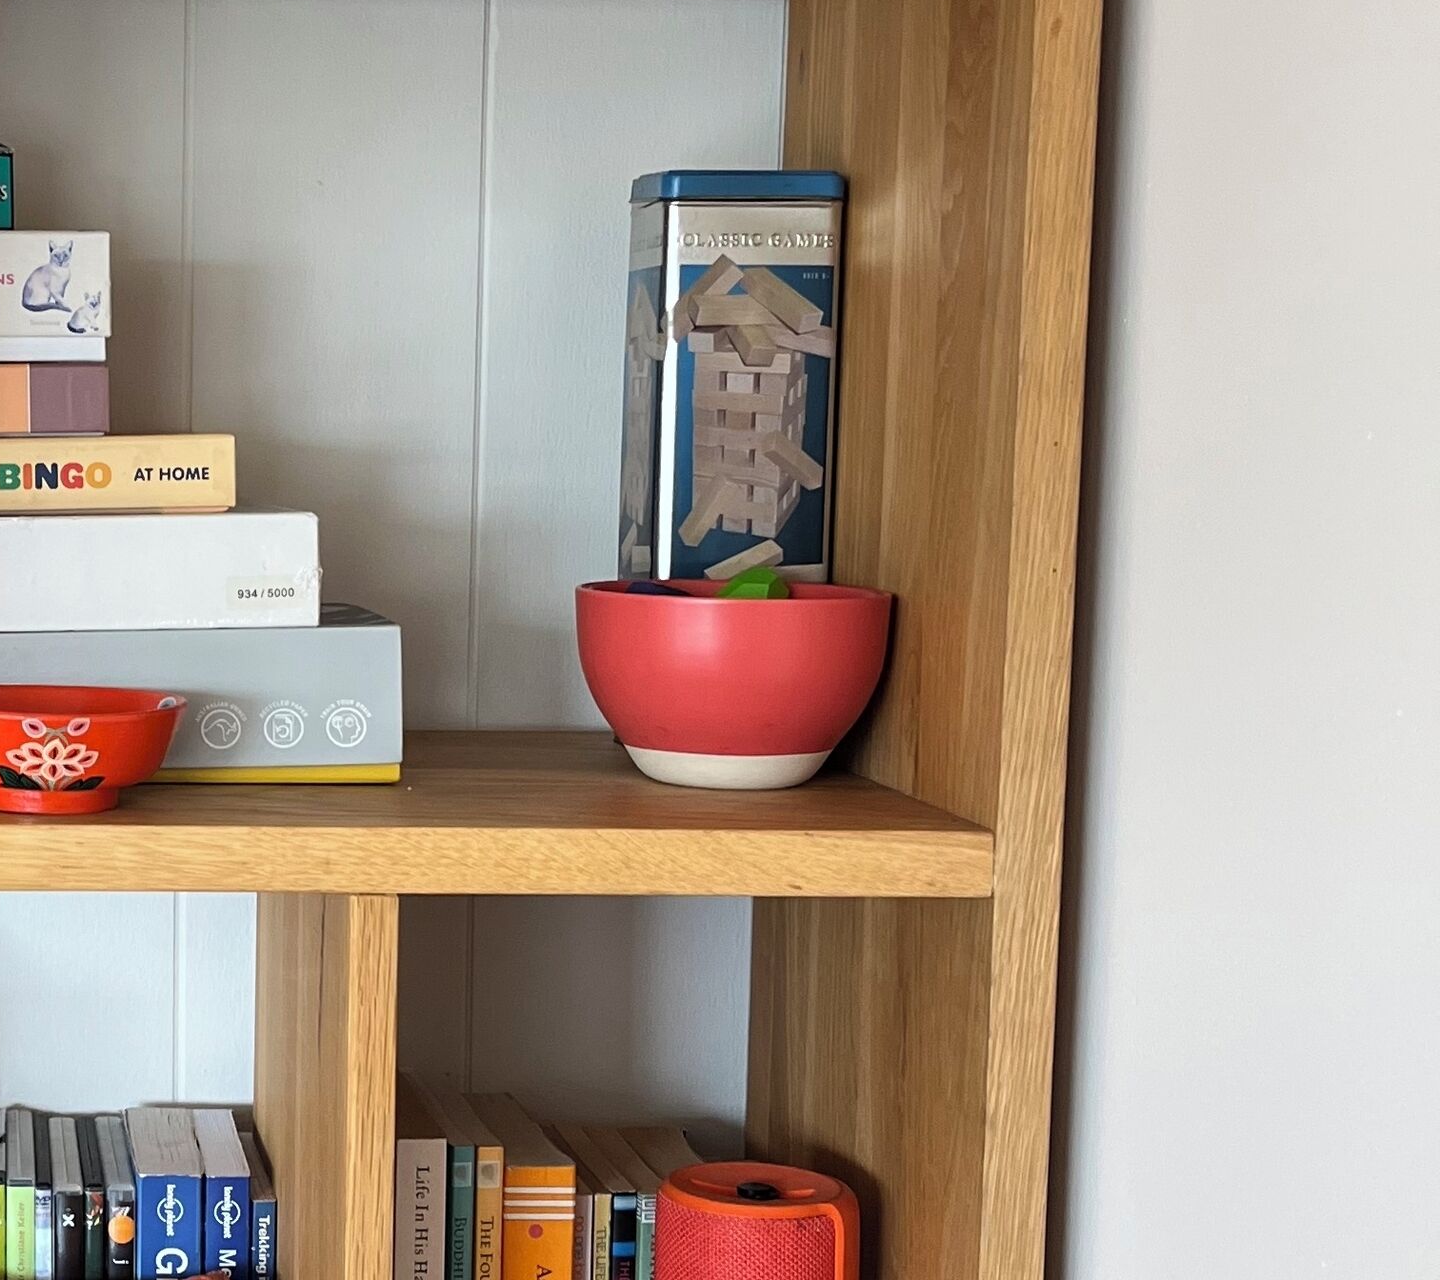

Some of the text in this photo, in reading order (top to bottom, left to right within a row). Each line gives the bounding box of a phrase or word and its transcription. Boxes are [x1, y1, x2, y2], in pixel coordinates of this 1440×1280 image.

[680, 232, 836, 248] CLASSIC GAMES
[133, 467, 155, 481] AT
[159, 466, 211, 481] HOME
[415, 1166, 430, 1199] Life
[415, 1204, 430, 1222] In
[255, 1215, 271, 1274] Trekking
[414, 1228, 429, 1256] His
